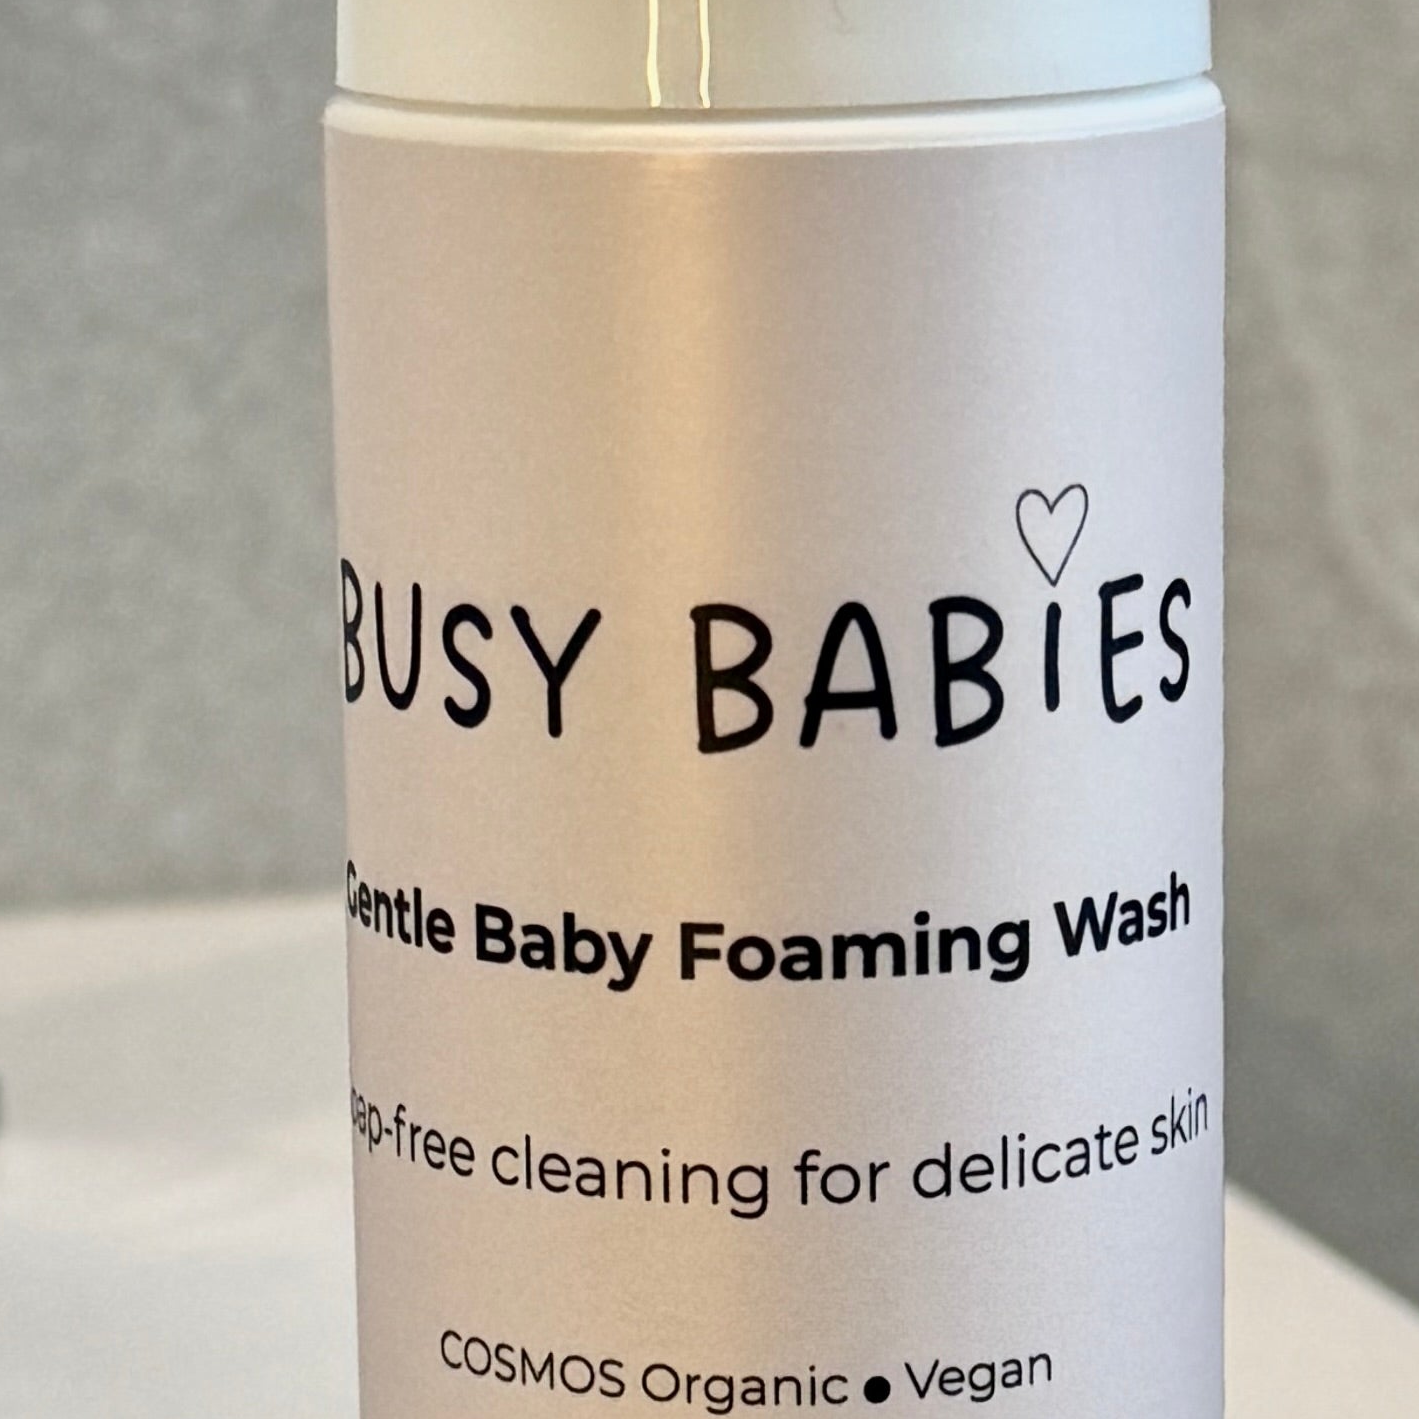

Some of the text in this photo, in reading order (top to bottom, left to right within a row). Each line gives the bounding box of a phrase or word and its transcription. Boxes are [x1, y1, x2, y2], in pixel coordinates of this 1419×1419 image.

[340, 557, 603, 739] BUSY
[346, 859, 1191, 993] Gentle Baby Foaming Wash
[350, 1086, 1208, 1220] oap-free cleaning for delicate skin
[440, 1329, 1054, 1416] COSMOS Organic Vegan
